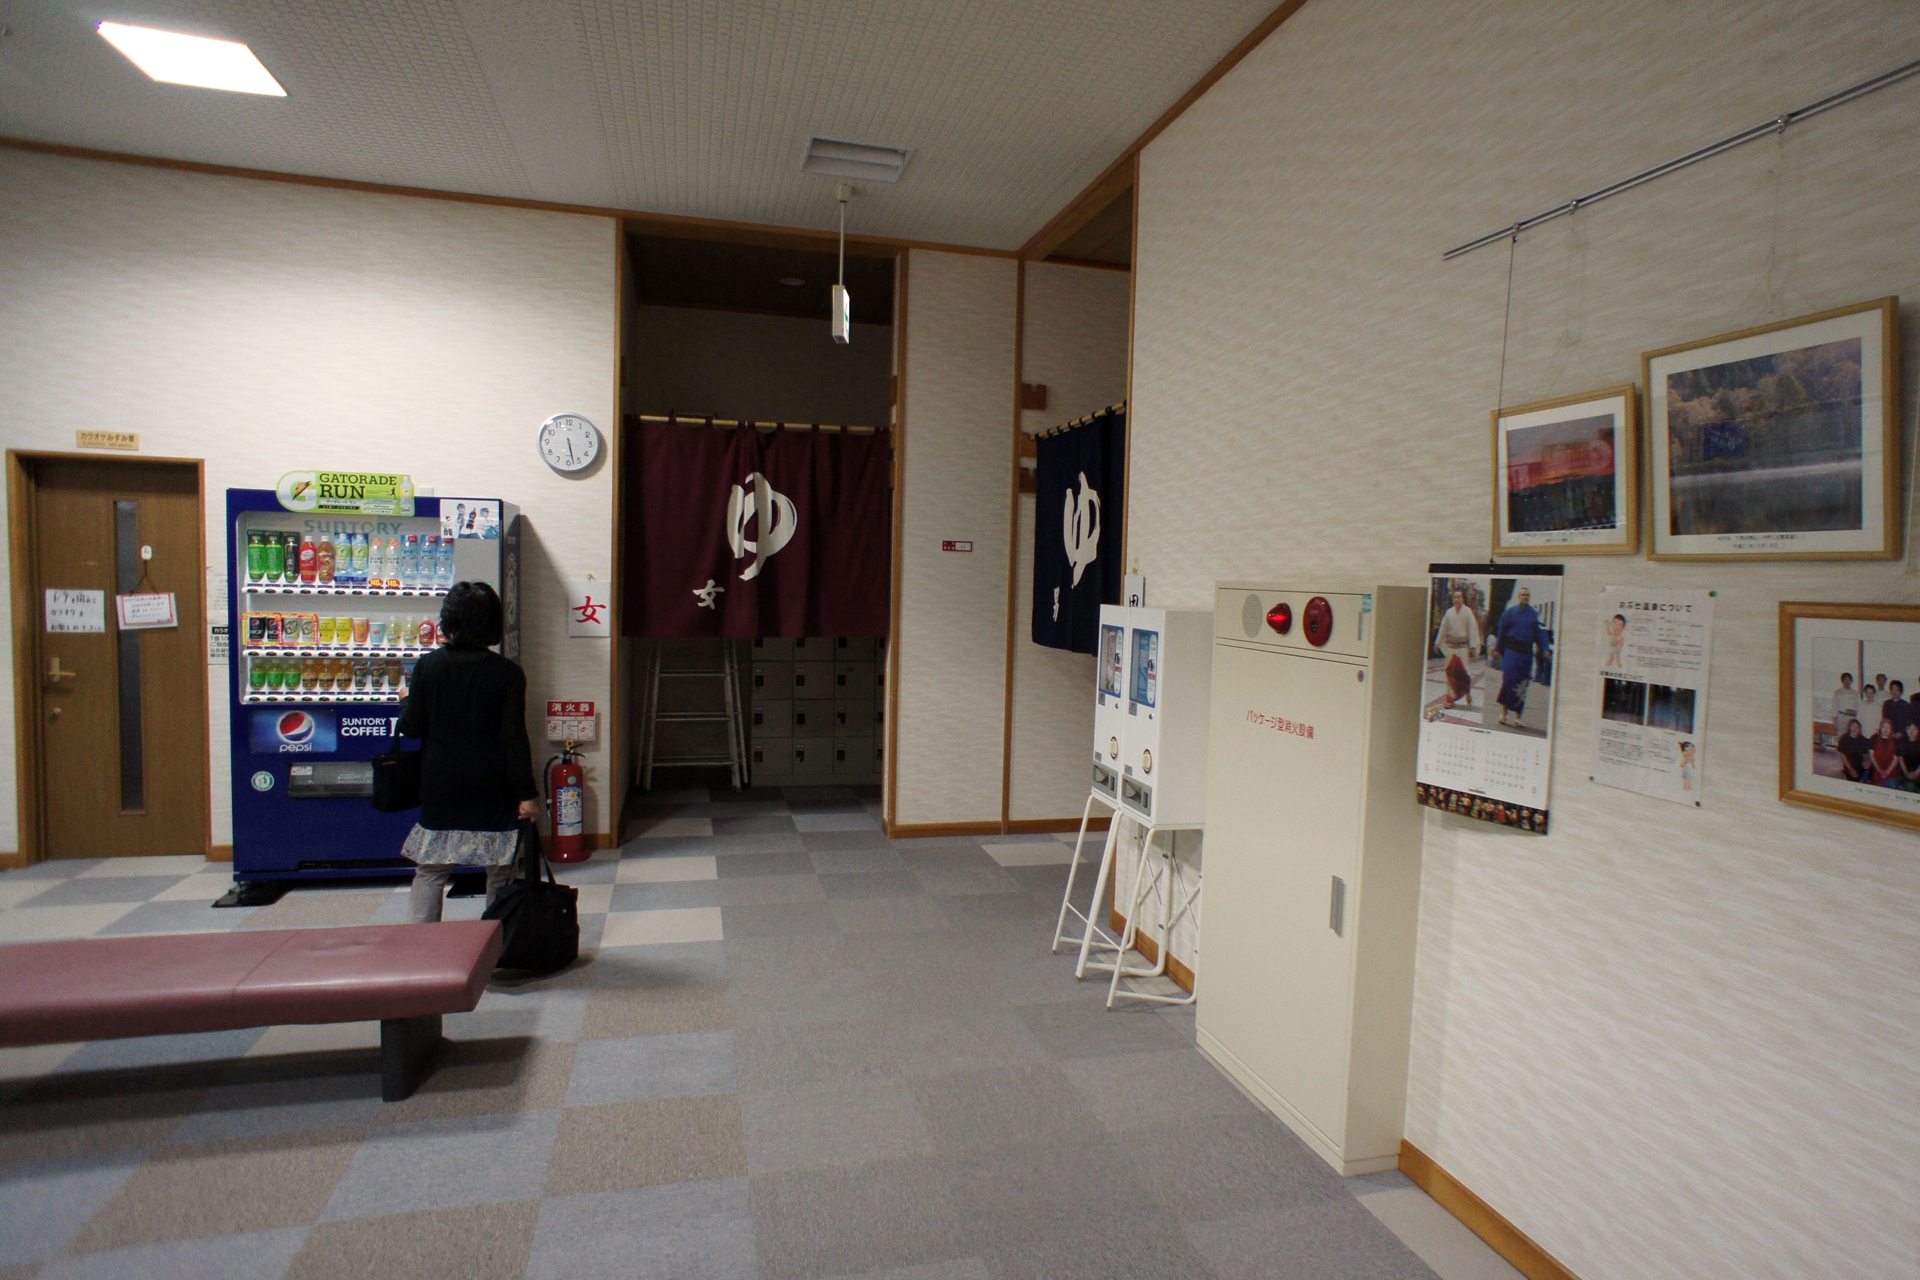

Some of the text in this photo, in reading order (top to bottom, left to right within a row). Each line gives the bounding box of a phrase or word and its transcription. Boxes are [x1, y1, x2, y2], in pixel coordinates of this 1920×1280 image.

[565, 418, 573, 426] 12
[579, 422, 582, 430] 1
[588, 440, 593, 448] 3
[547, 448, 553, 456] 8
[556, 455, 560, 463] 7
[319, 473, 398, 486] GATORADE
[319, 483, 366, 500] RUN
[726, 471, 798, 581] ゆ
[1063, 470, 1101, 589] ゆ
[692, 579, 725, 610] 女
[572, 595, 607, 625] 女
[552, 702, 590, 712] 消火器
[341, 717, 387, 726] SUNTORY
[1246, 709, 1315, 740] パッケージ型消火設備
[341, 726, 387, 736] COFFEE
[279, 742, 313, 753] pepsi
